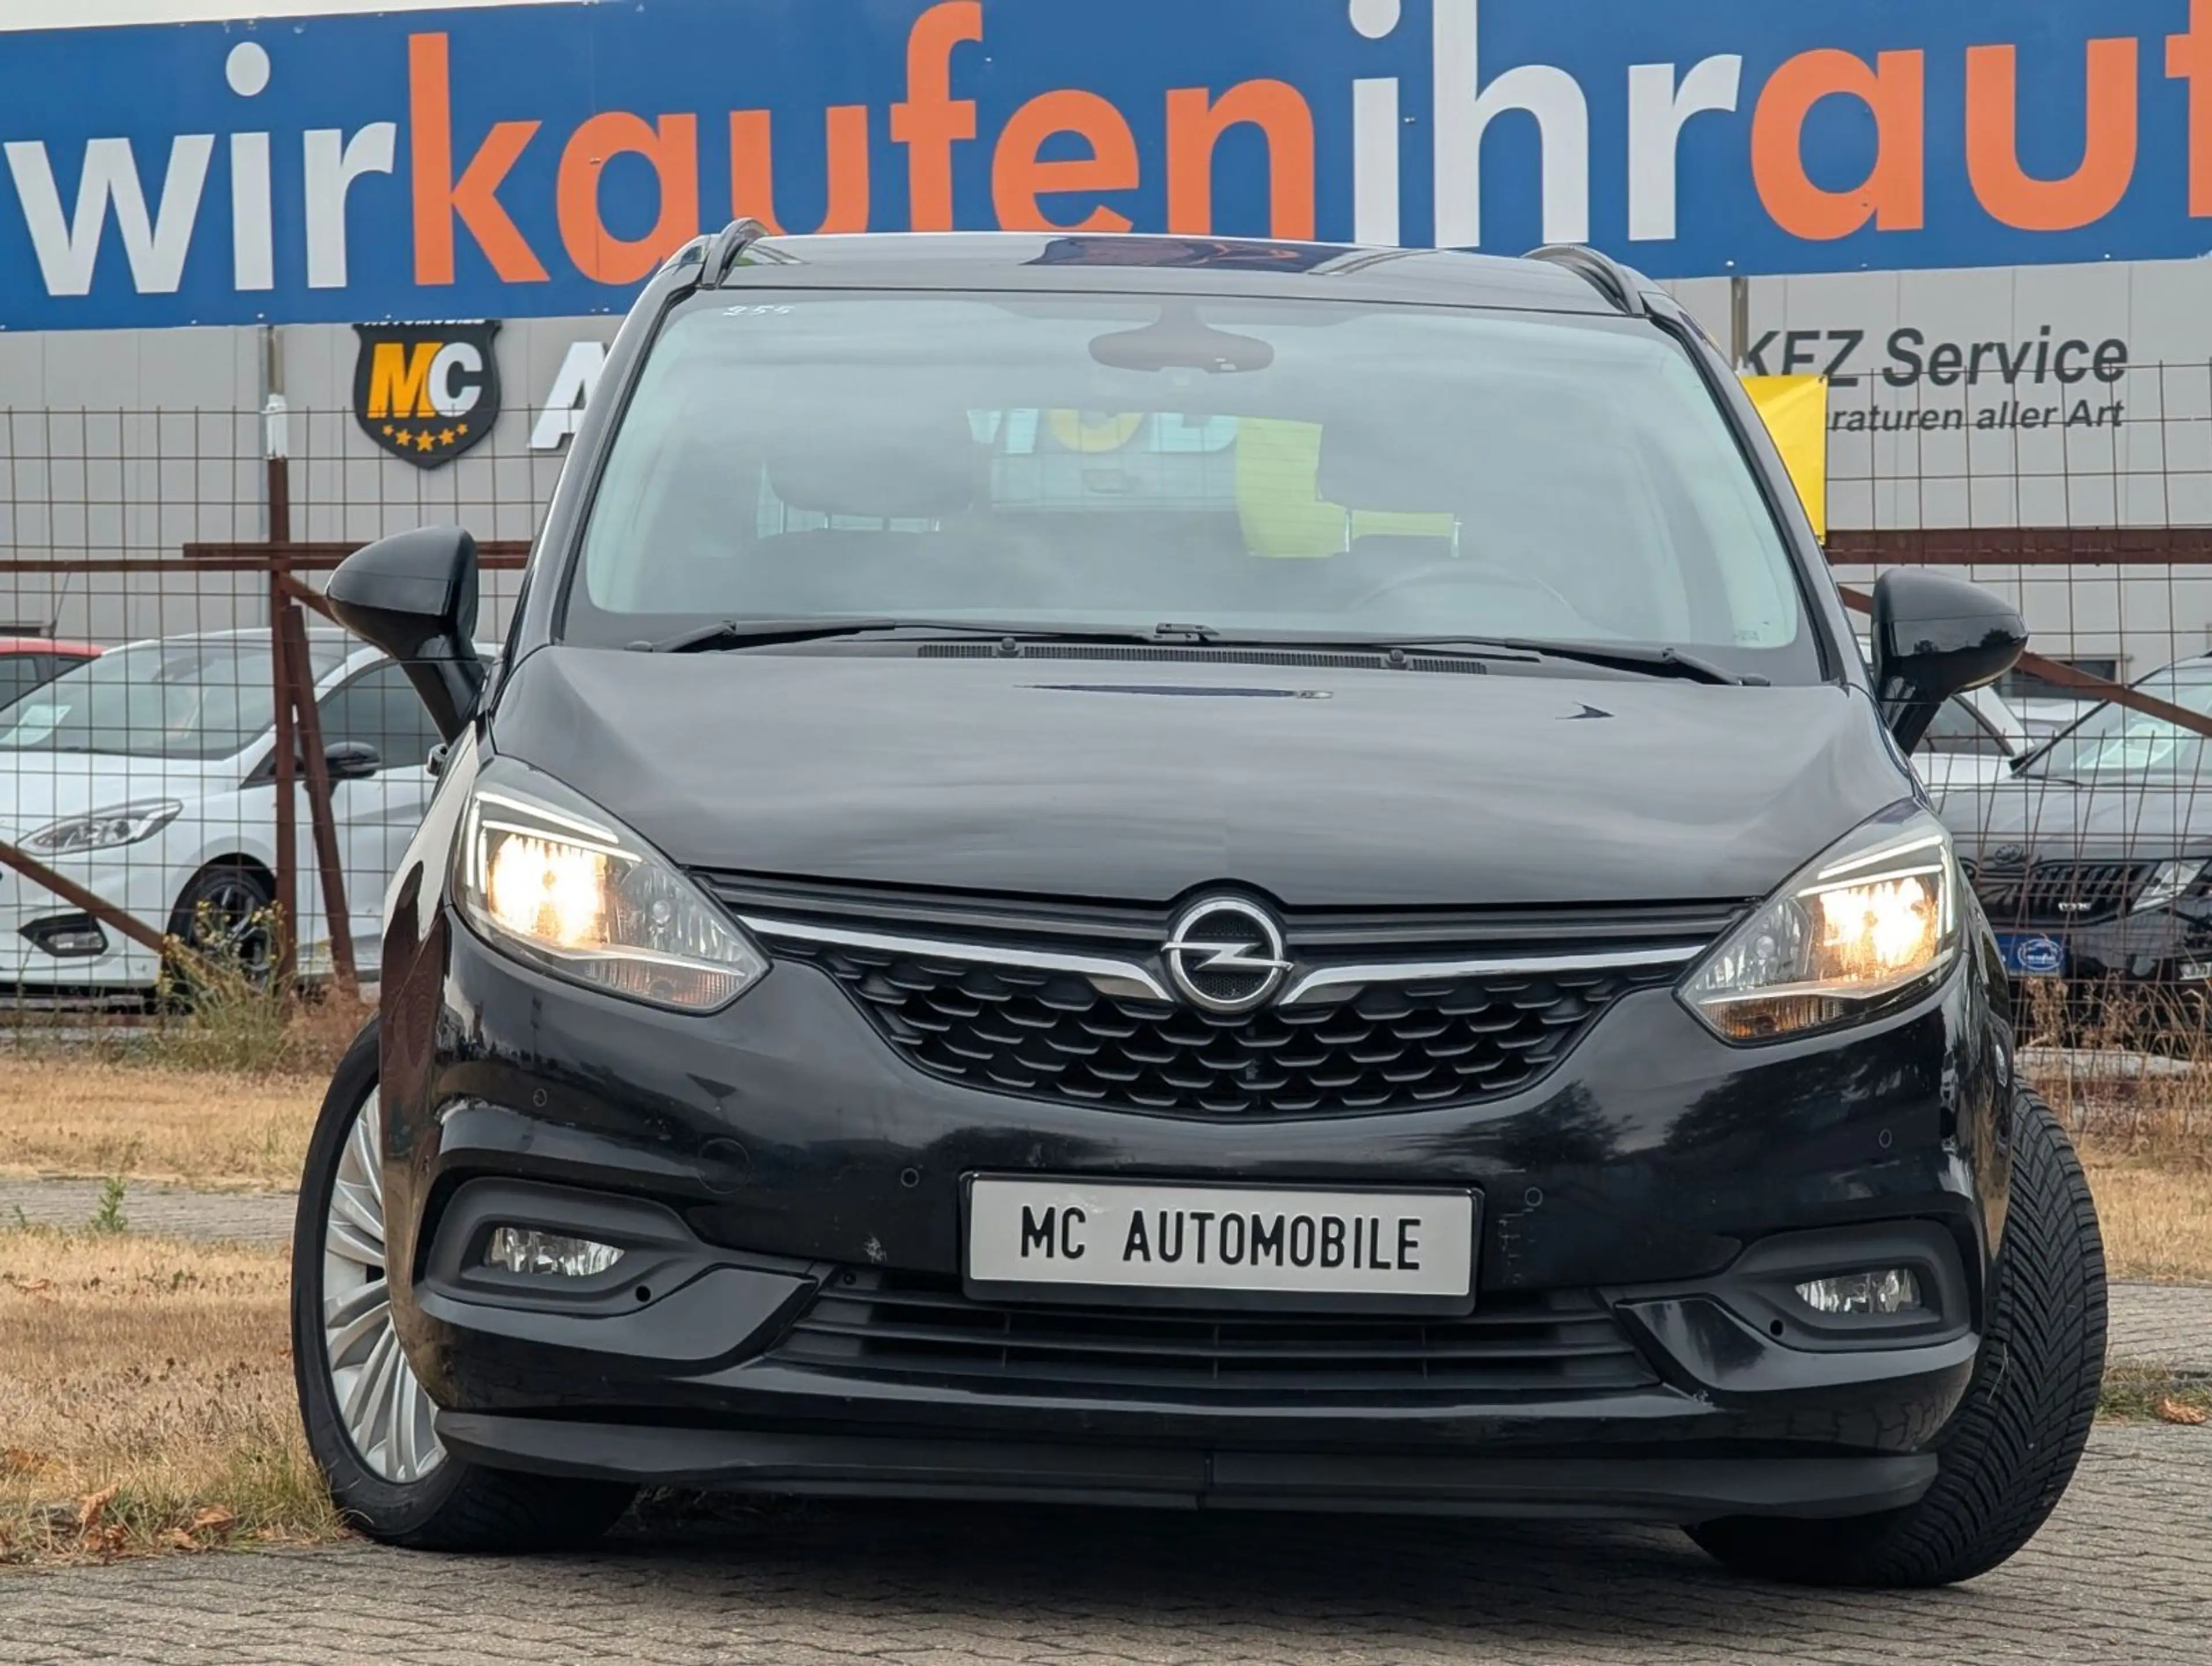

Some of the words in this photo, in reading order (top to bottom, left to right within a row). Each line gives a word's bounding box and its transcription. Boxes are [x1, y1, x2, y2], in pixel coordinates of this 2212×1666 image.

[367, 342, 483, 418] MC
[1882, 325, 2128, 387] Service
[1826, 406, 1963, 432] raturen
[1977, 401, 2059, 429] aller
[2066, 399, 2125, 427] Art
[1021, 1206, 1086, 1260] MC
[1122, 1210, 1422, 1271] AUTOMOBILE
